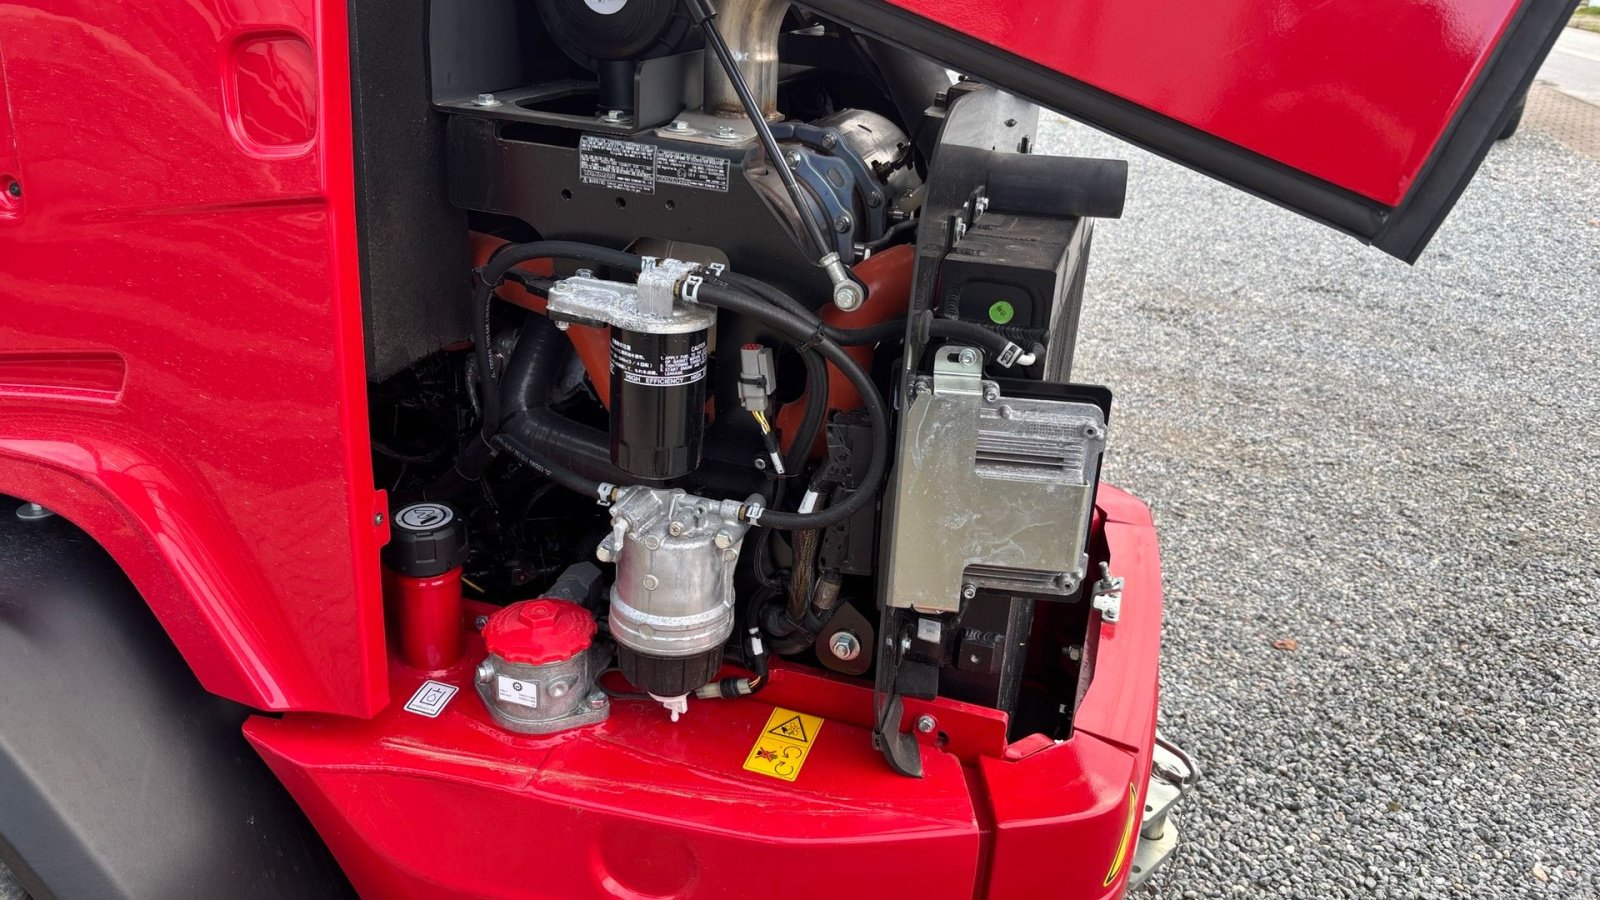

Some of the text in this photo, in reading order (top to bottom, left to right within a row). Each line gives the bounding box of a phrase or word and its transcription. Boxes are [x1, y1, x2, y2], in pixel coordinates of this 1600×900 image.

[584, 169, 616, 180] YANMAR
[657, 177, 690, 186] YANMAR
[626, 372, 702, 386] HIGH EFFICIENCY HIGH
